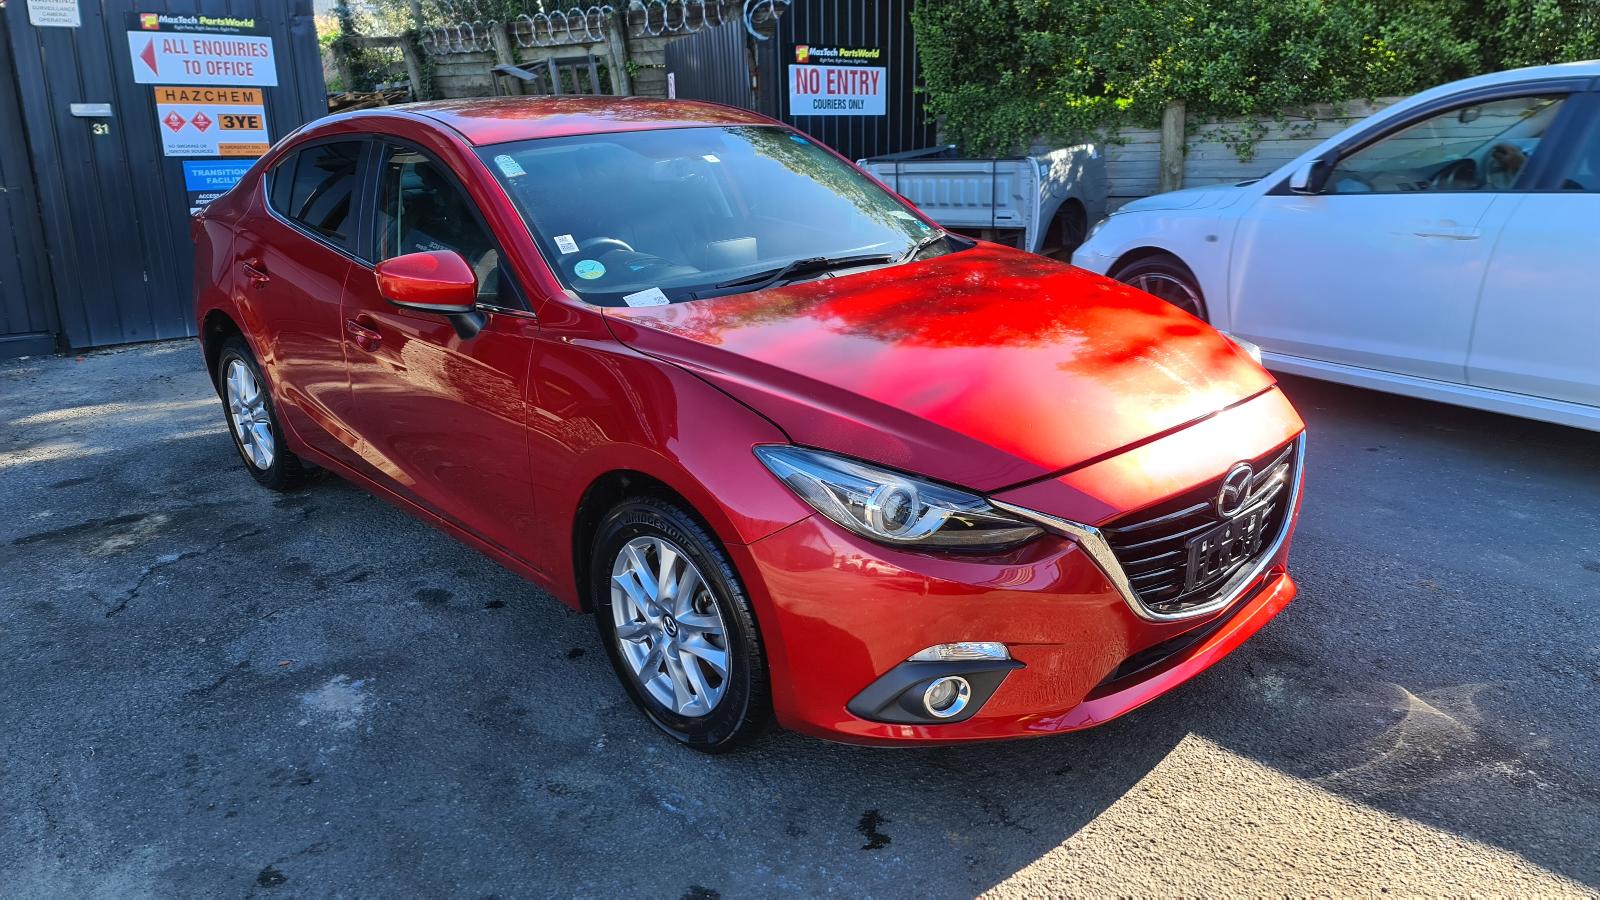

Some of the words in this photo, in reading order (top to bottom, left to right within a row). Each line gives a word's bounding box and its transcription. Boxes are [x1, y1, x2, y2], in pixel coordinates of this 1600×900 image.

[158, 14, 198, 24] MaxTech
[199, 16, 255, 28] PartsWorld
[163, 38, 189, 54] ALL
[193, 39, 269, 58] ENQUIRIES
[809, 47, 838, 57] MaxTech
[839, 48, 880, 58] PartsWorld
[182, 60, 201, 75] TO
[206, 60, 254, 77] OFFICE
[796, 67, 820, 95] NO
[827, 69, 880, 95] ENTRY
[165, 90, 254, 103] HAZCHEM
[813, 99, 847, 110] COURIERS
[848, 99, 865, 110] ONLY
[223, 115, 259, 129] 3YE
[92, 123, 109, 135] 31
[192, 168, 247, 177] TRANSITION
[206, 176, 241, 184] FACILIT
